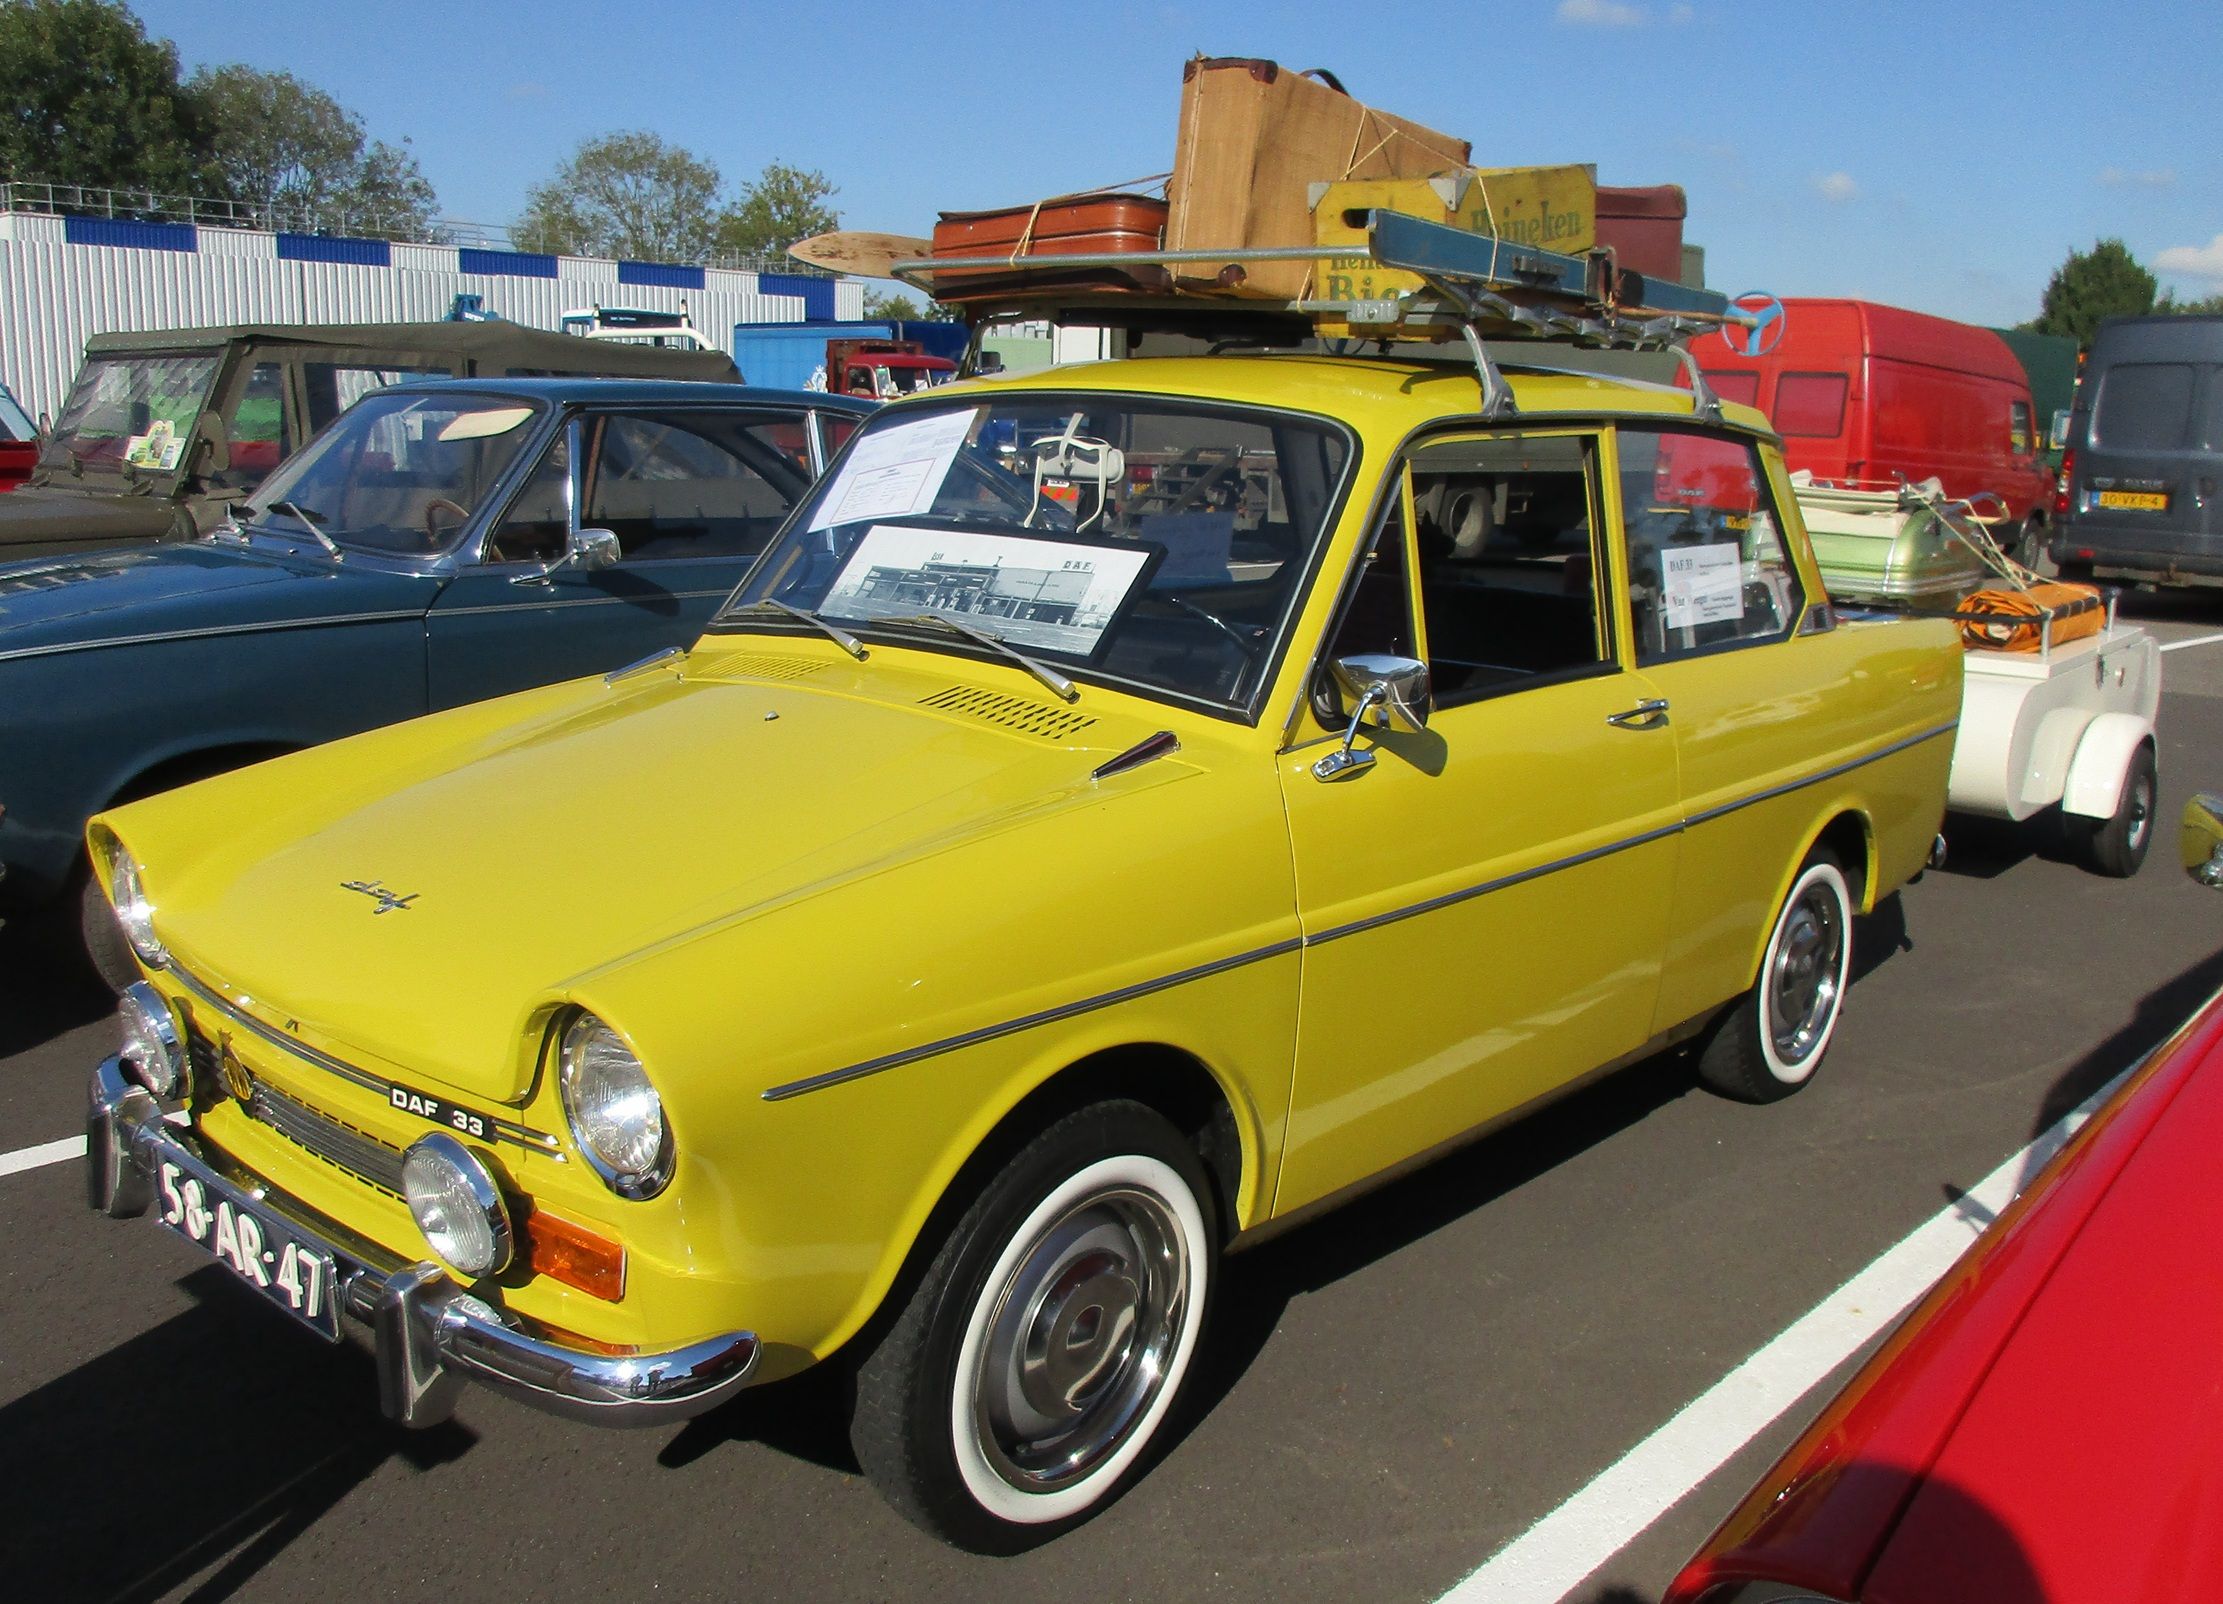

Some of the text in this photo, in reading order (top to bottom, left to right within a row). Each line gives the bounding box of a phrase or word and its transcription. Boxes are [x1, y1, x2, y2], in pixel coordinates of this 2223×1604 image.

[1062, 560, 1092, 571] DAF
[392, 1087, 484, 1137] DAF 33
[160, 1160, 325, 1319] 58-AR-47
